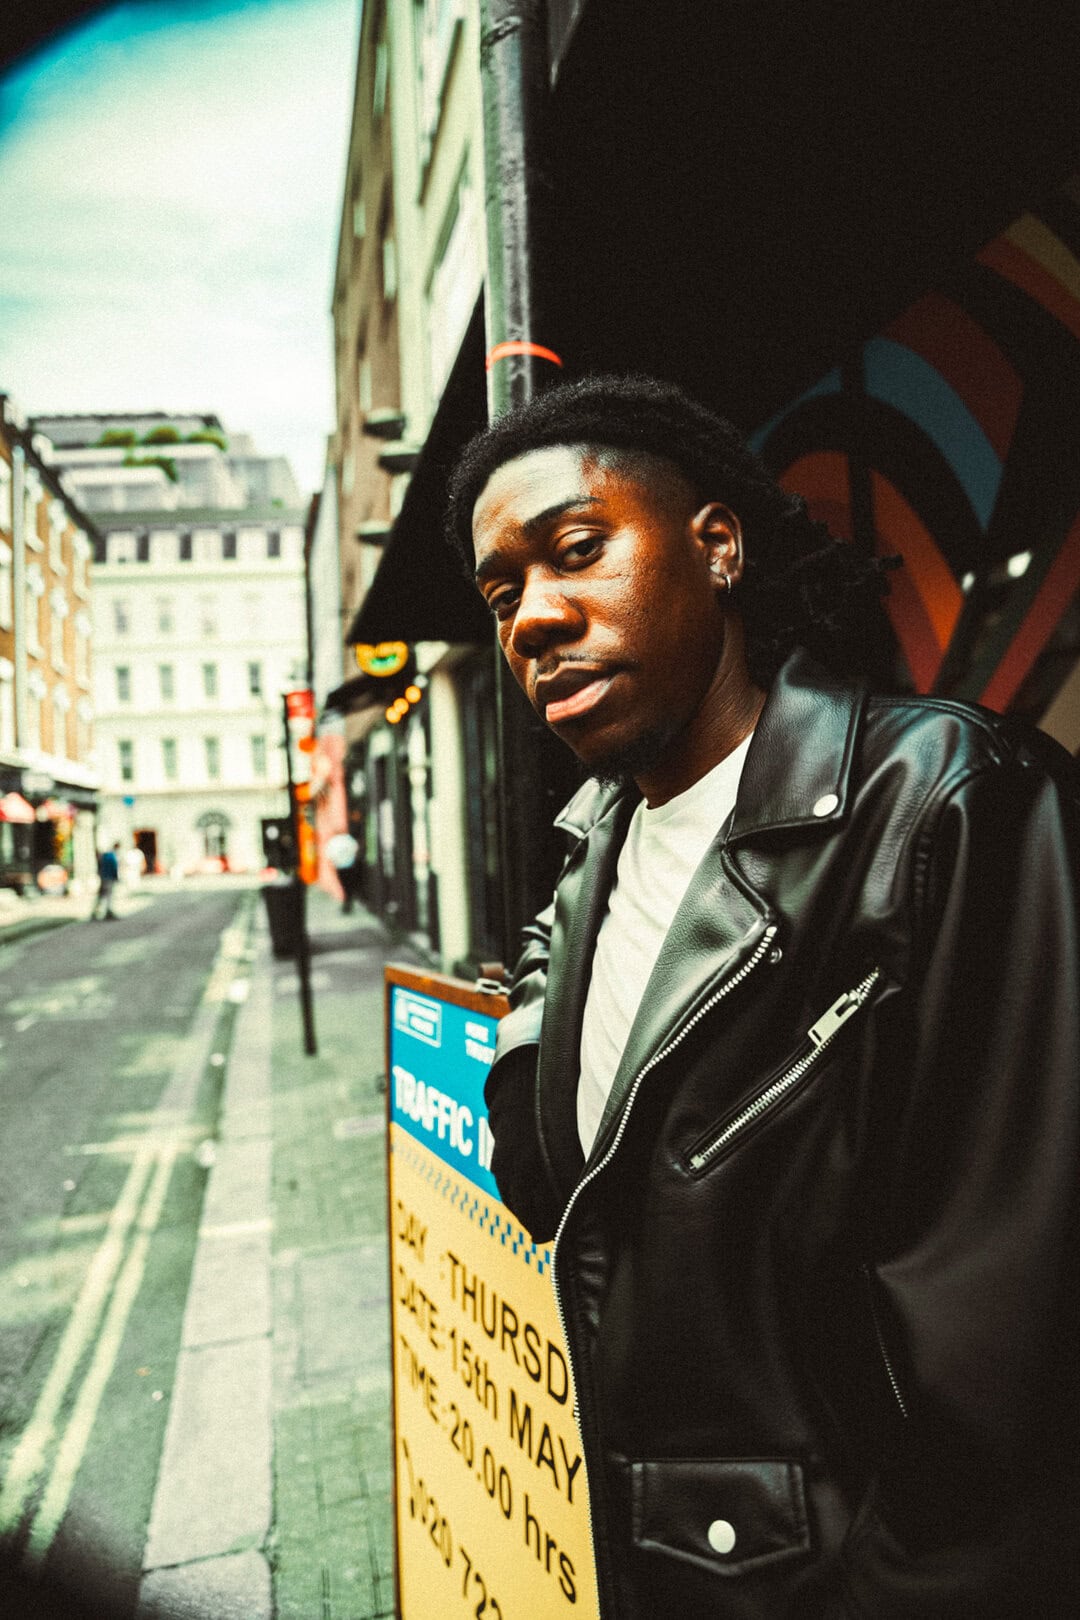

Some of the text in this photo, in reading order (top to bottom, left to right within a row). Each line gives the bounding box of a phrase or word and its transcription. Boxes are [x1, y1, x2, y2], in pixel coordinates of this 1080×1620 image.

[392, 1064, 474, 1157] TRAFFIC
[447, 1250, 569, 1405] THURSD
[510, 1387, 582, 1505] MAY
[525, 1492, 578, 1605] hrs
